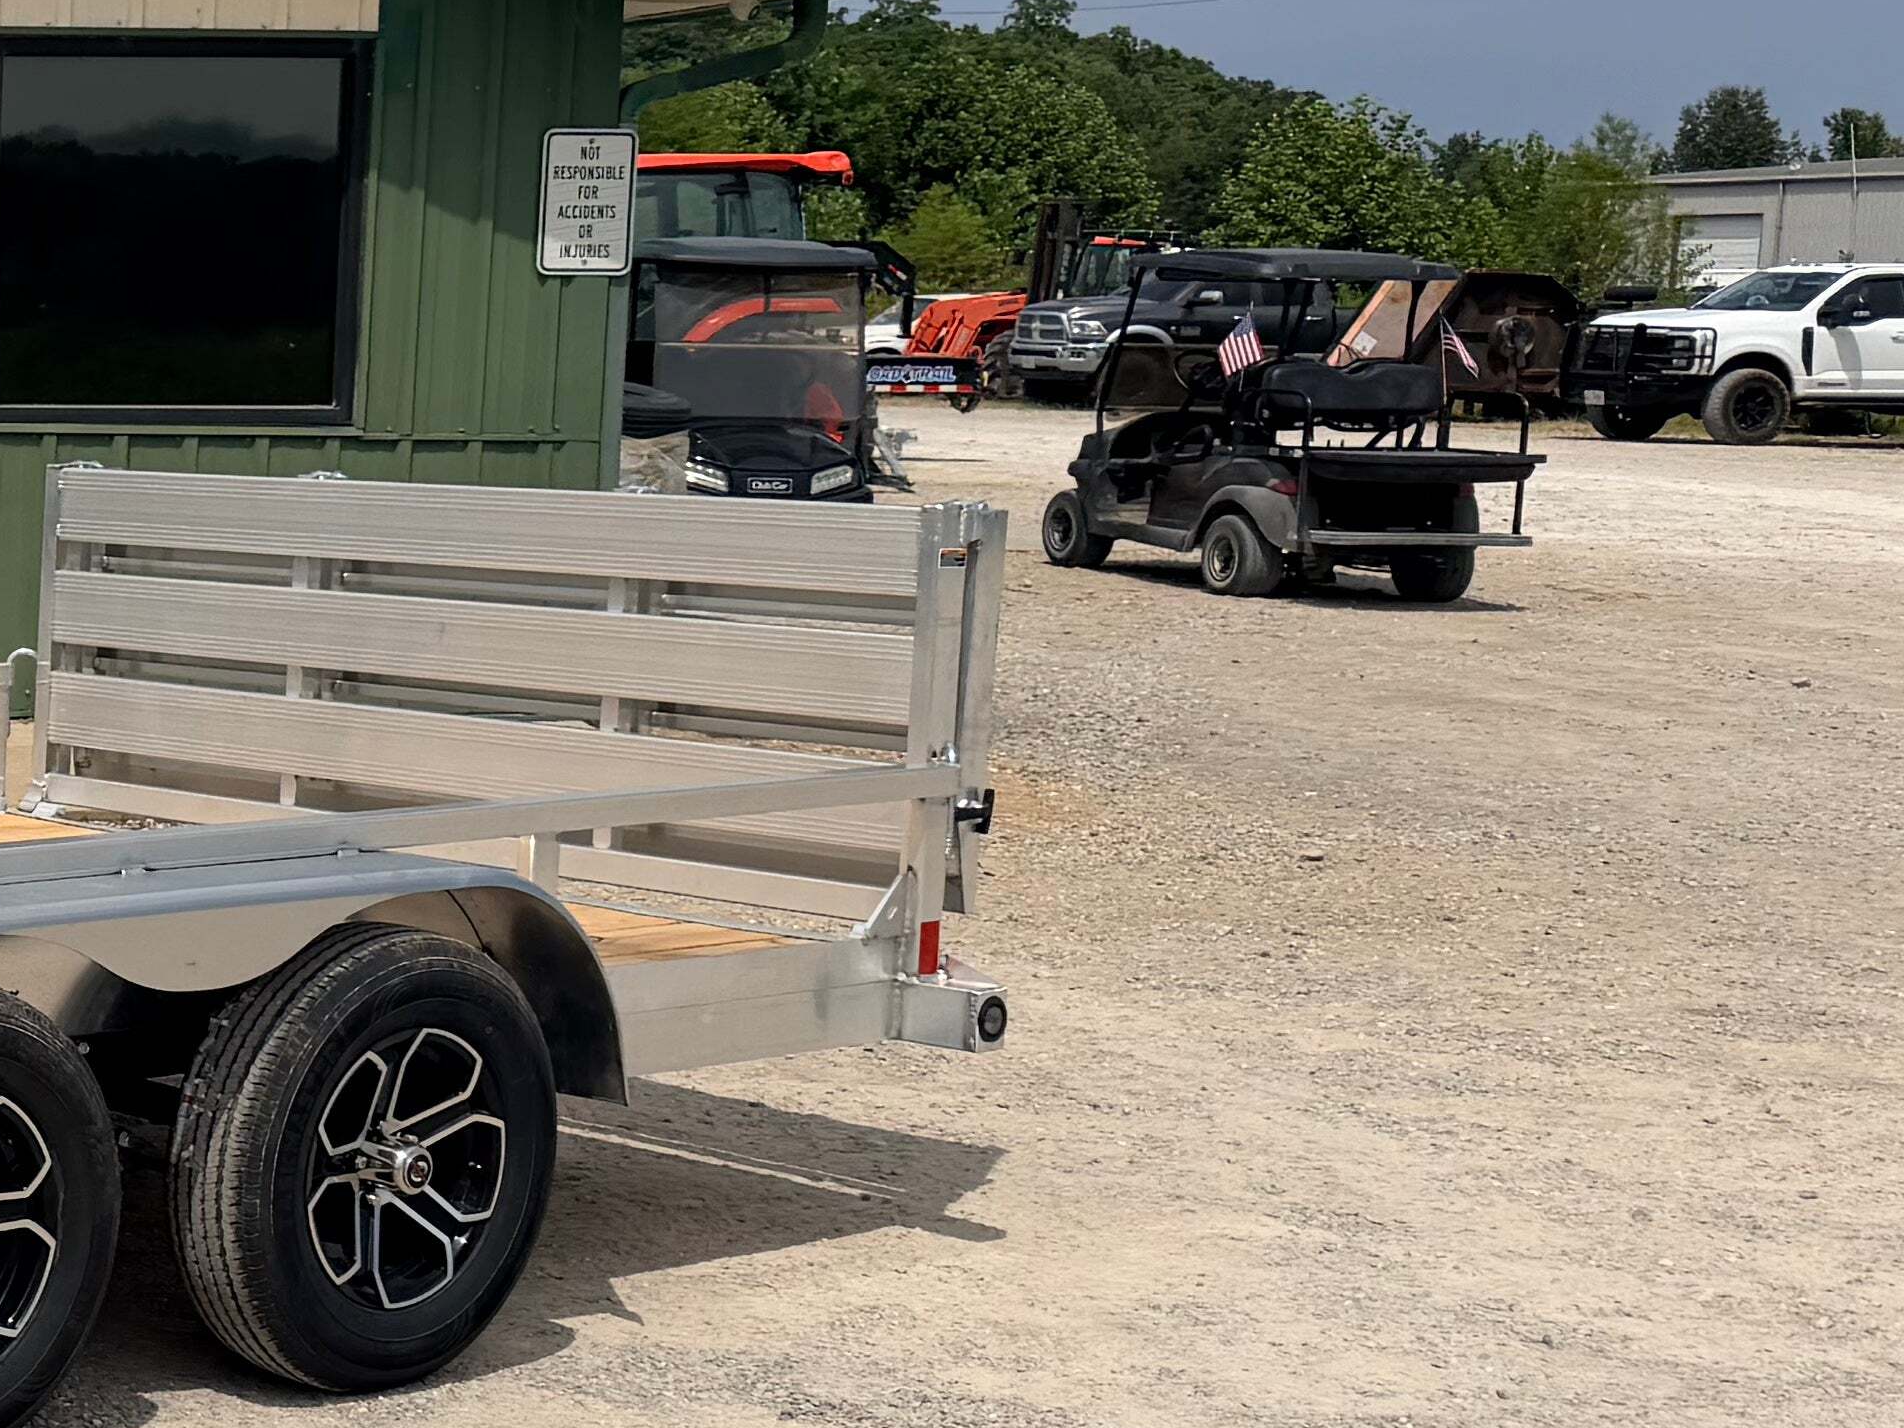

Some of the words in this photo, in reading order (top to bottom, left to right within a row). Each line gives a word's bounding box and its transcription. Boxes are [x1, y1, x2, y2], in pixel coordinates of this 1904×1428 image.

[580, 145, 601, 160] NOT
[552, 165, 625, 180] RESPONSIBLE
[577, 185, 599, 200] FOR
[557, 204, 617, 220] ACCIDENTS
[578, 224, 593, 239] OR
[559, 243, 611, 259] INJURIES
